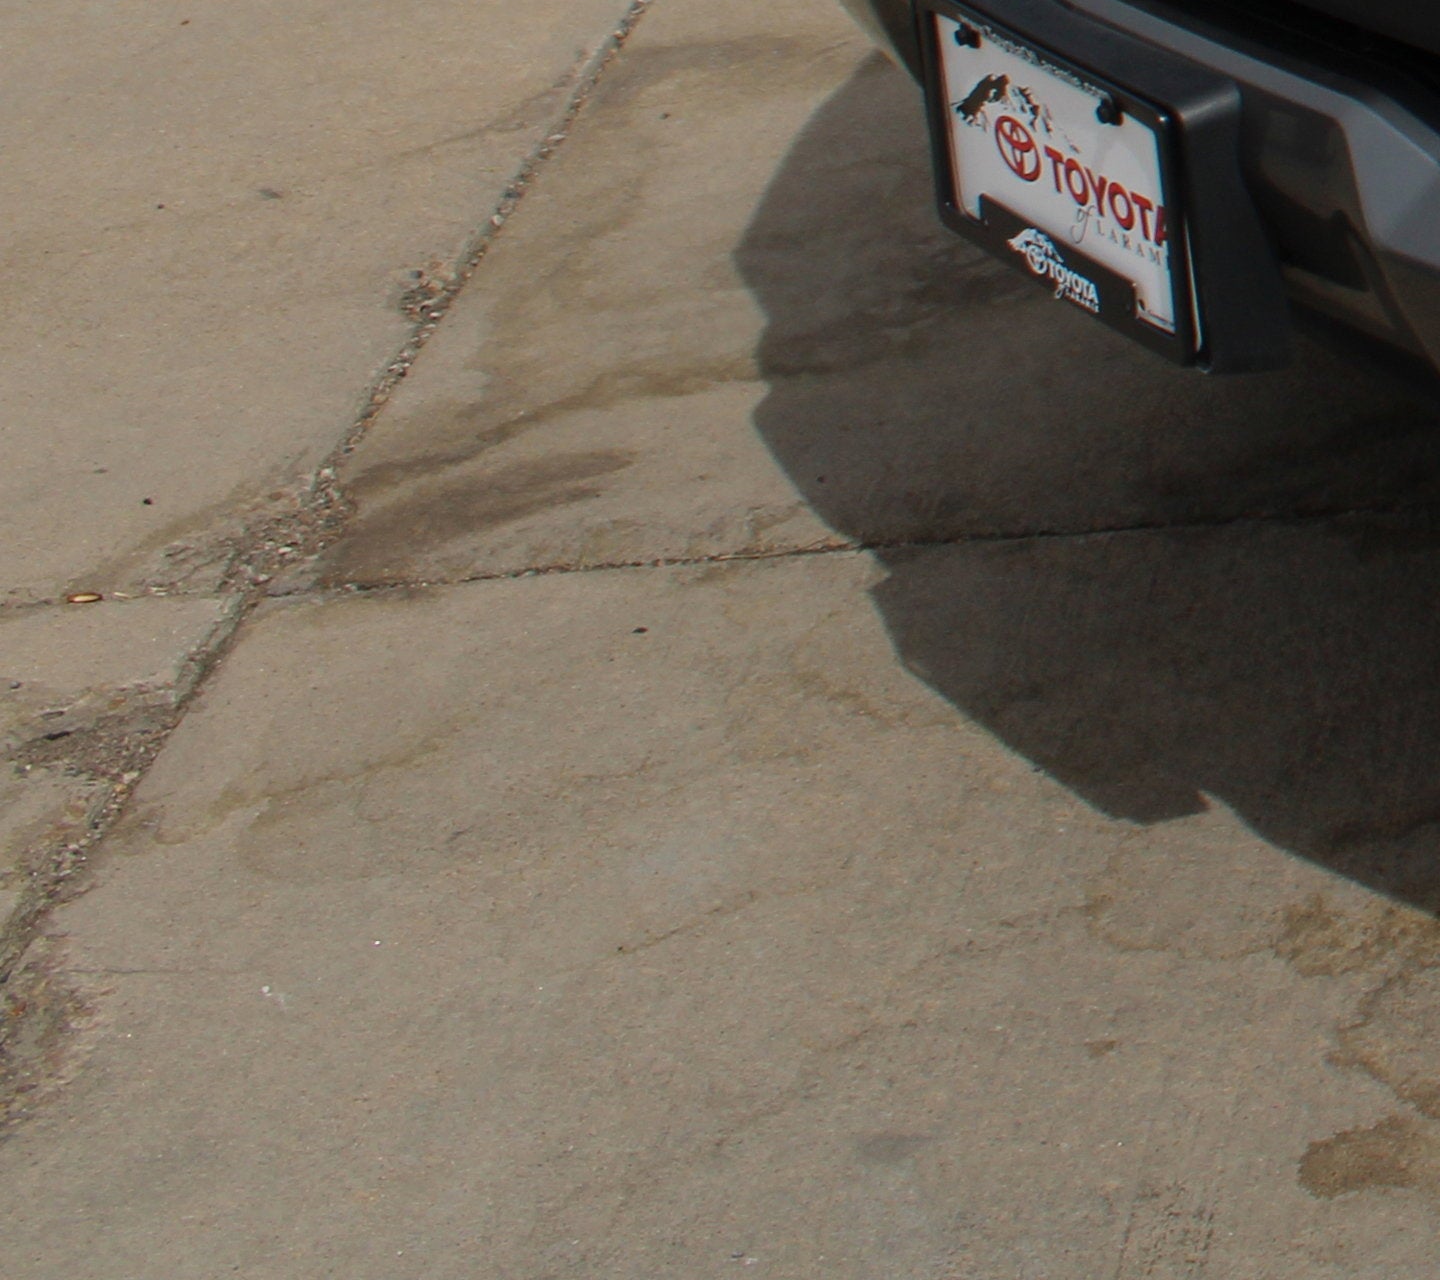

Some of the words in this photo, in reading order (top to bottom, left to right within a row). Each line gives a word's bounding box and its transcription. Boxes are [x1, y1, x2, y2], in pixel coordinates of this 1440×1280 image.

[1071, 205, 1096, 244] of
[1096, 219, 1162, 266] LARAM
[1046, 259, 1100, 305] TOYOTA
